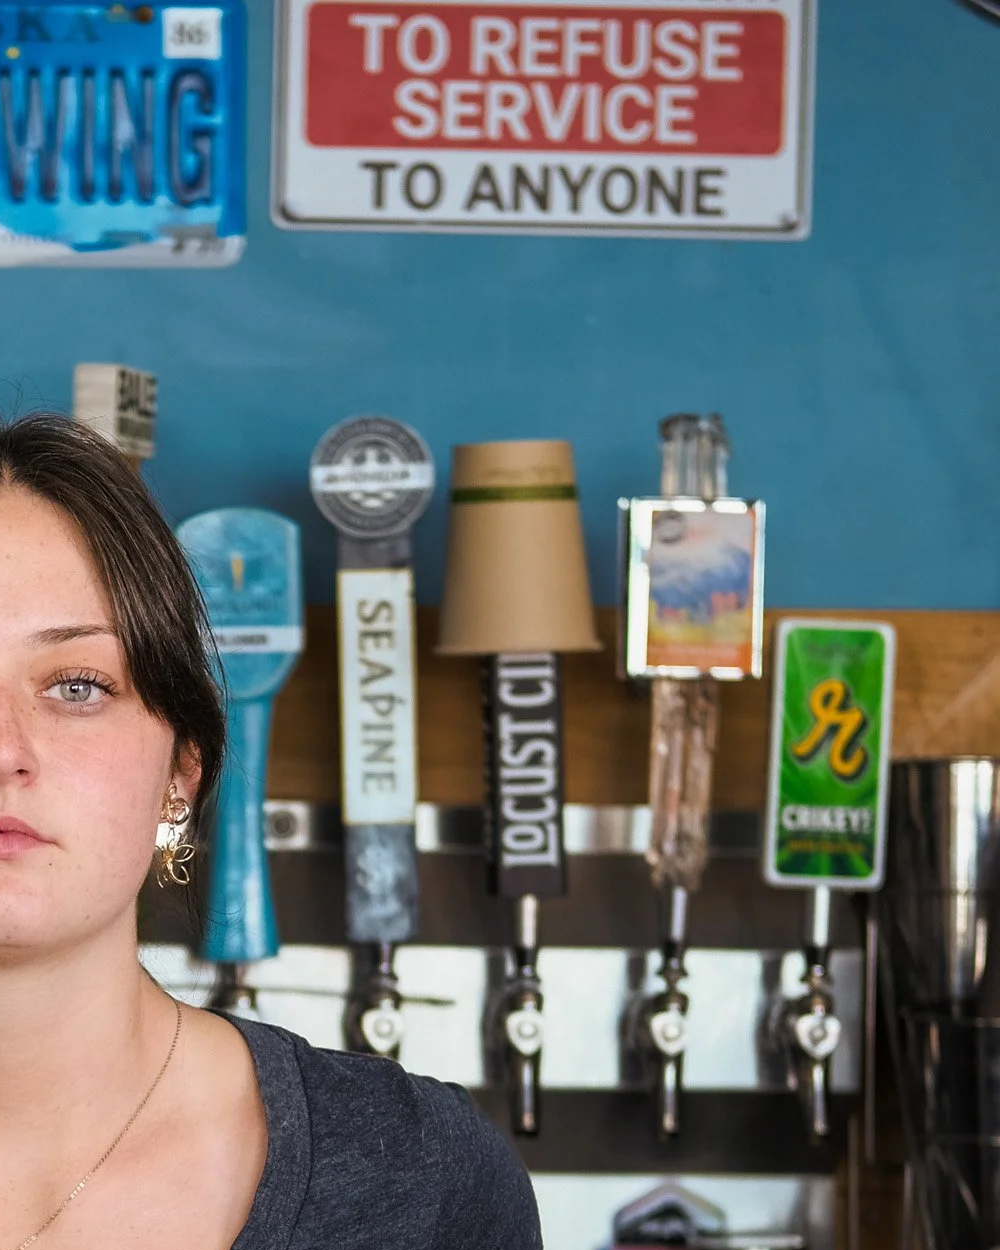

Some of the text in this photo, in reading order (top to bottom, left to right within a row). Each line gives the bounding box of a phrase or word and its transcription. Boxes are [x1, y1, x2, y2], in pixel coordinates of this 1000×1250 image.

[349, 13, 744, 82] TO REFUSE
[392, 79, 697, 144] SERVICE
[360, 161, 728, 218] TO ANYONE
[356, 599, 397, 796] SEAPINE
[498, 713, 558, 868] LOCUST
[782, 804, 870, 835] CRIKEY!
